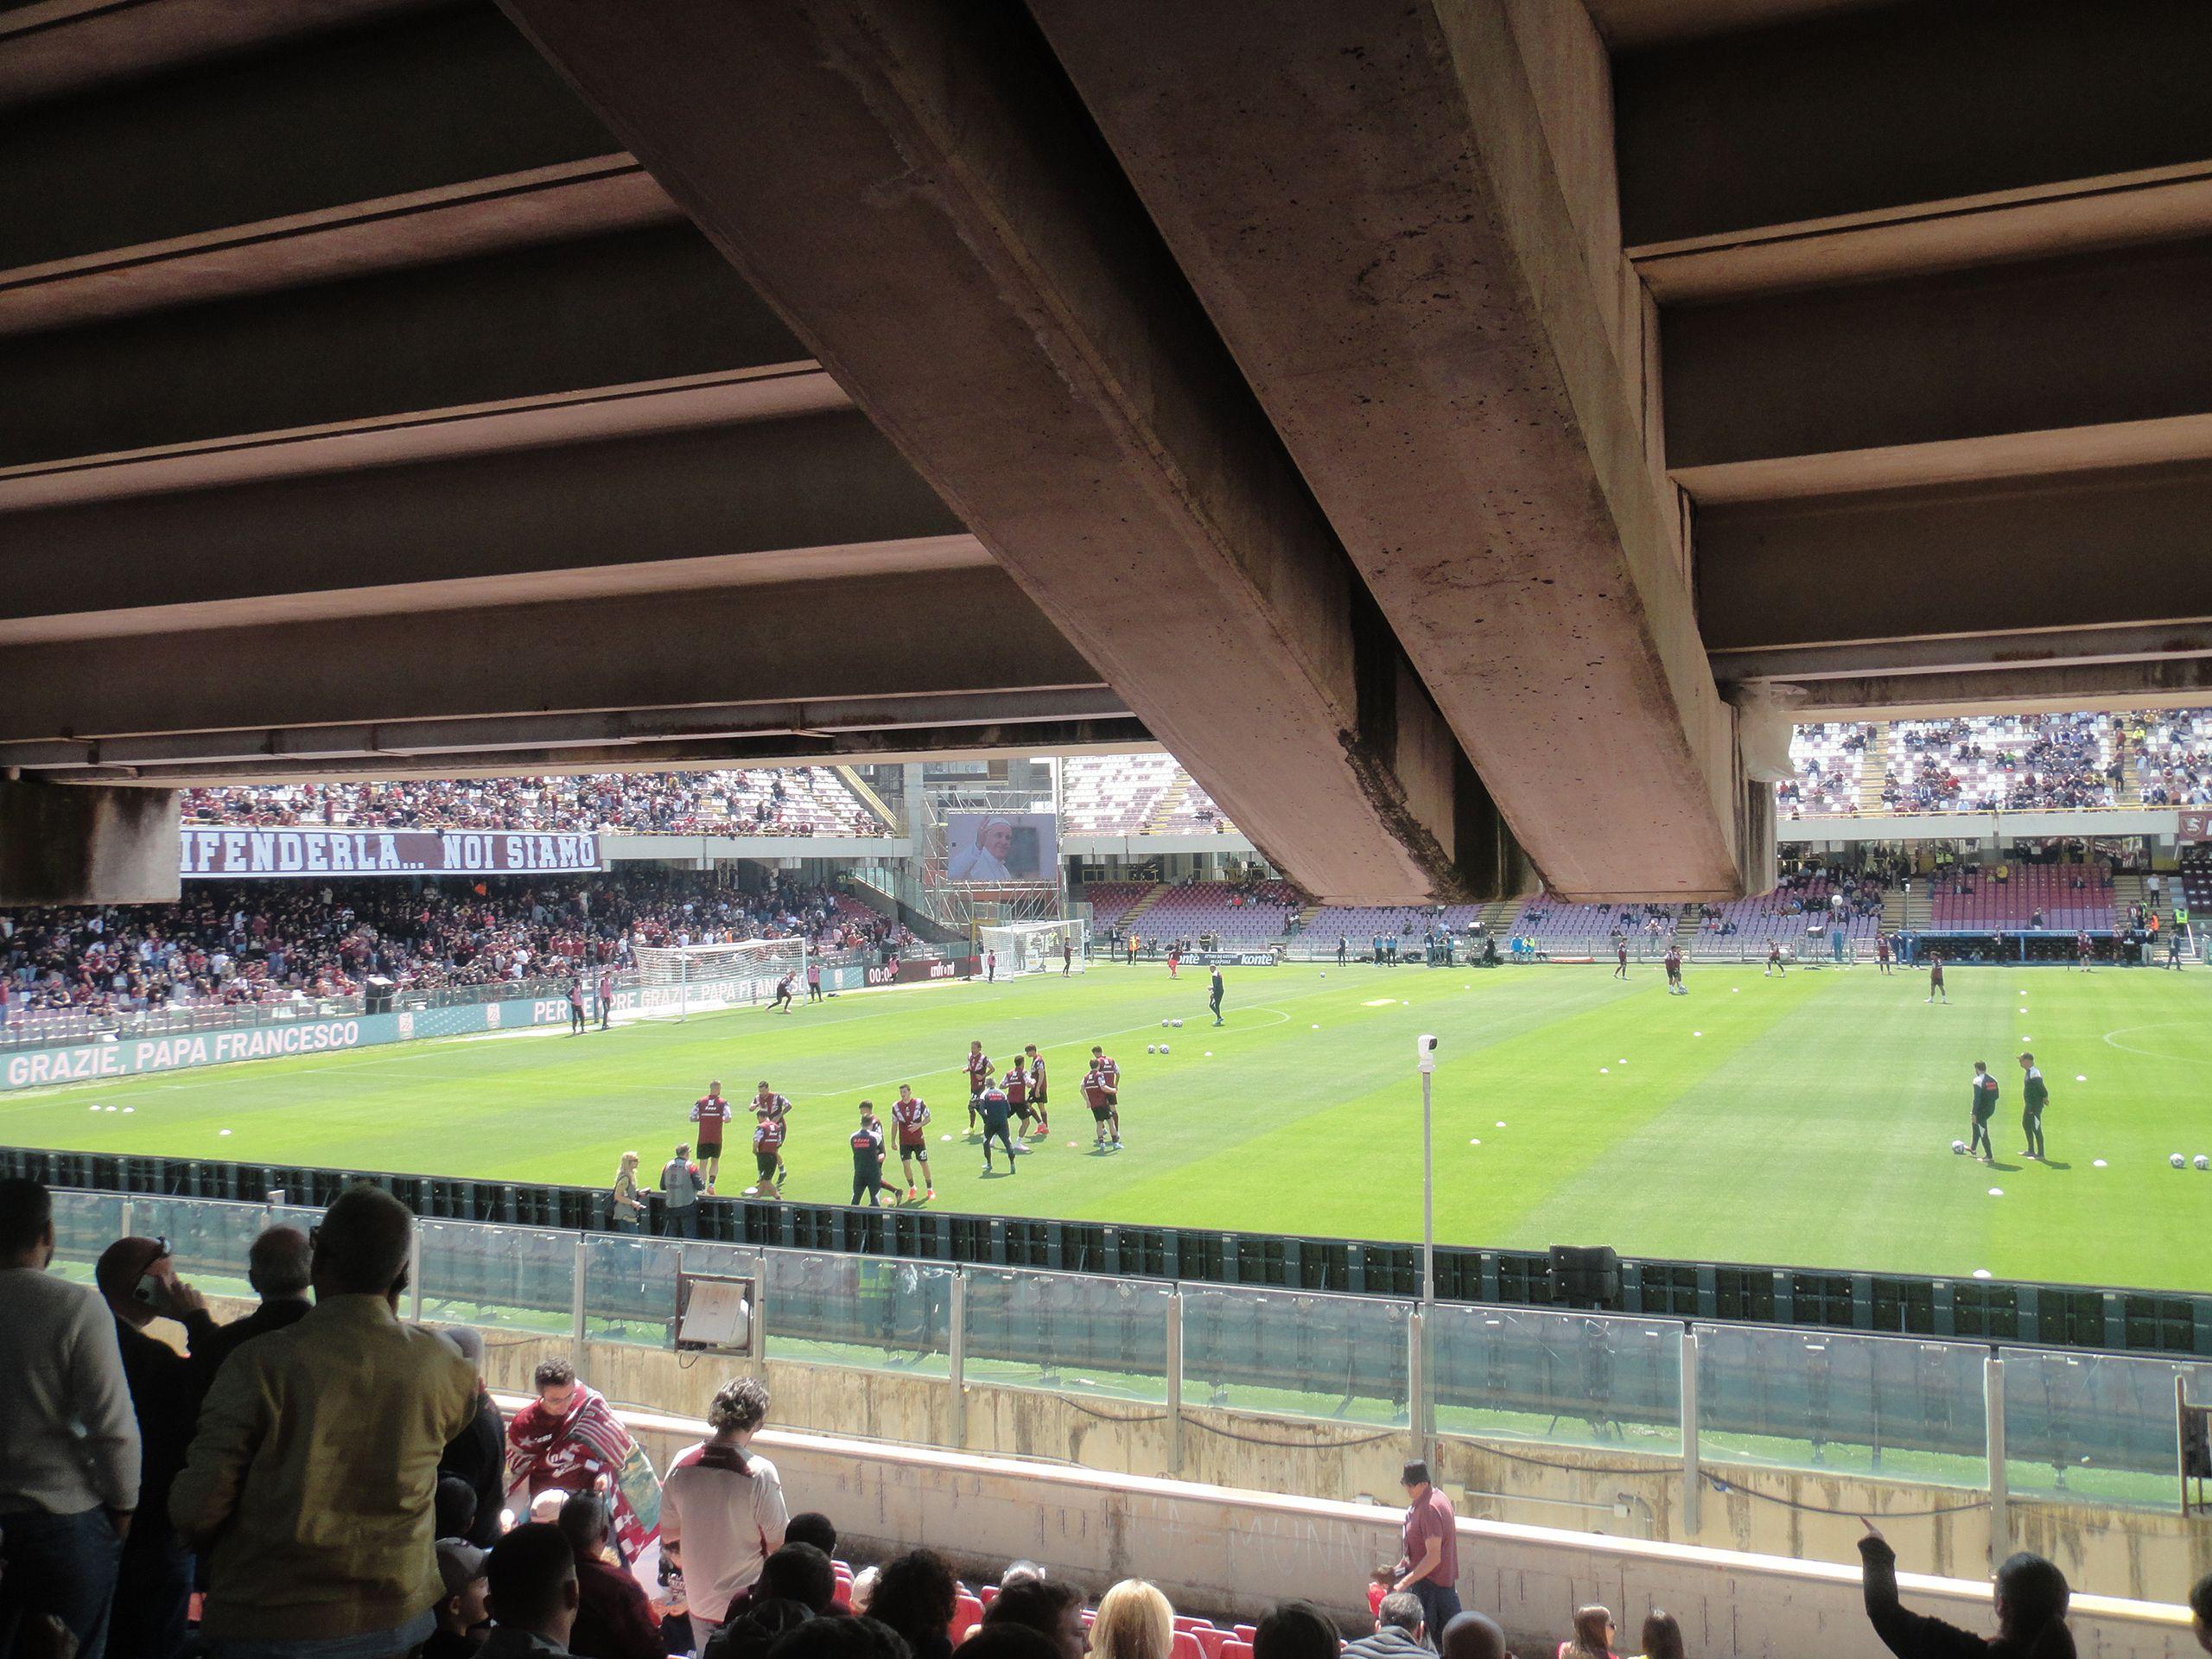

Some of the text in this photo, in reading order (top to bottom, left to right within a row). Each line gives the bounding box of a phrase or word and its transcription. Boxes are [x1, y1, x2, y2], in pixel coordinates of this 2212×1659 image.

[442, 835, 494, 869] NOI
[506, 835, 595, 869] SIAMO
[533, 999, 568, 1023] PER
[8, 1020, 359, 1086] GRAZIE, PAPA FRANCESCO
